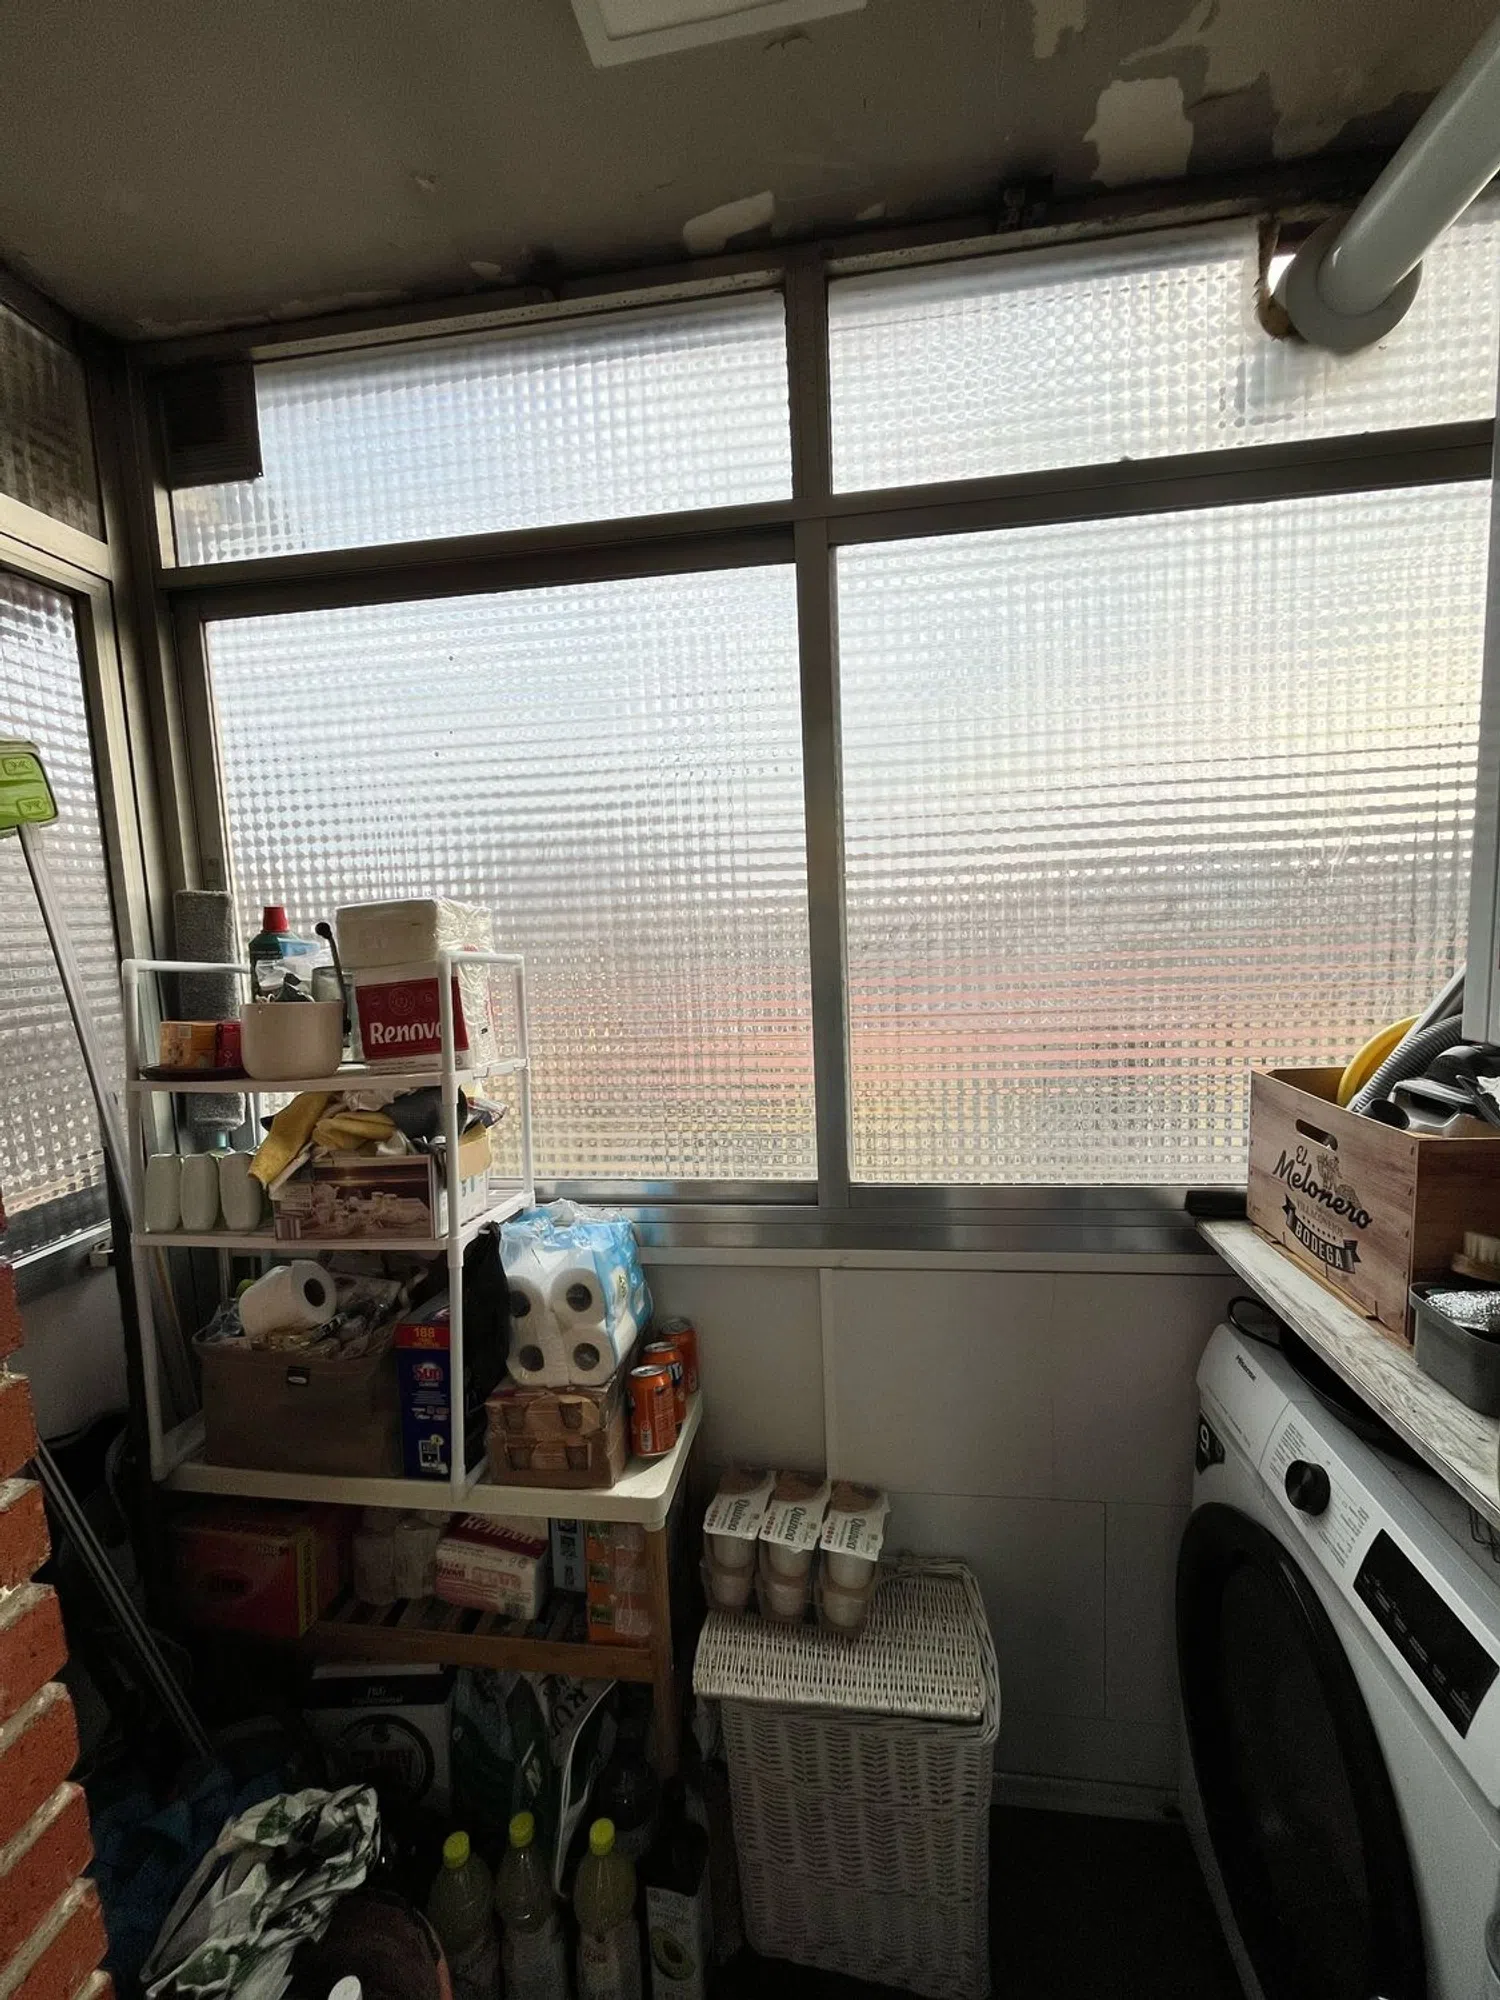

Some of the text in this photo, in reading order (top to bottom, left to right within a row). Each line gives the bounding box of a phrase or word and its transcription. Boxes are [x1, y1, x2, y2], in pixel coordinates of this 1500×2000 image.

[1295, 1145, 1308, 1166] El
[1272, 1150, 1373, 1229] Melonero
[1294, 1219, 1344, 1269] BODEGA
[413, 1327, 435, 1338] 188
